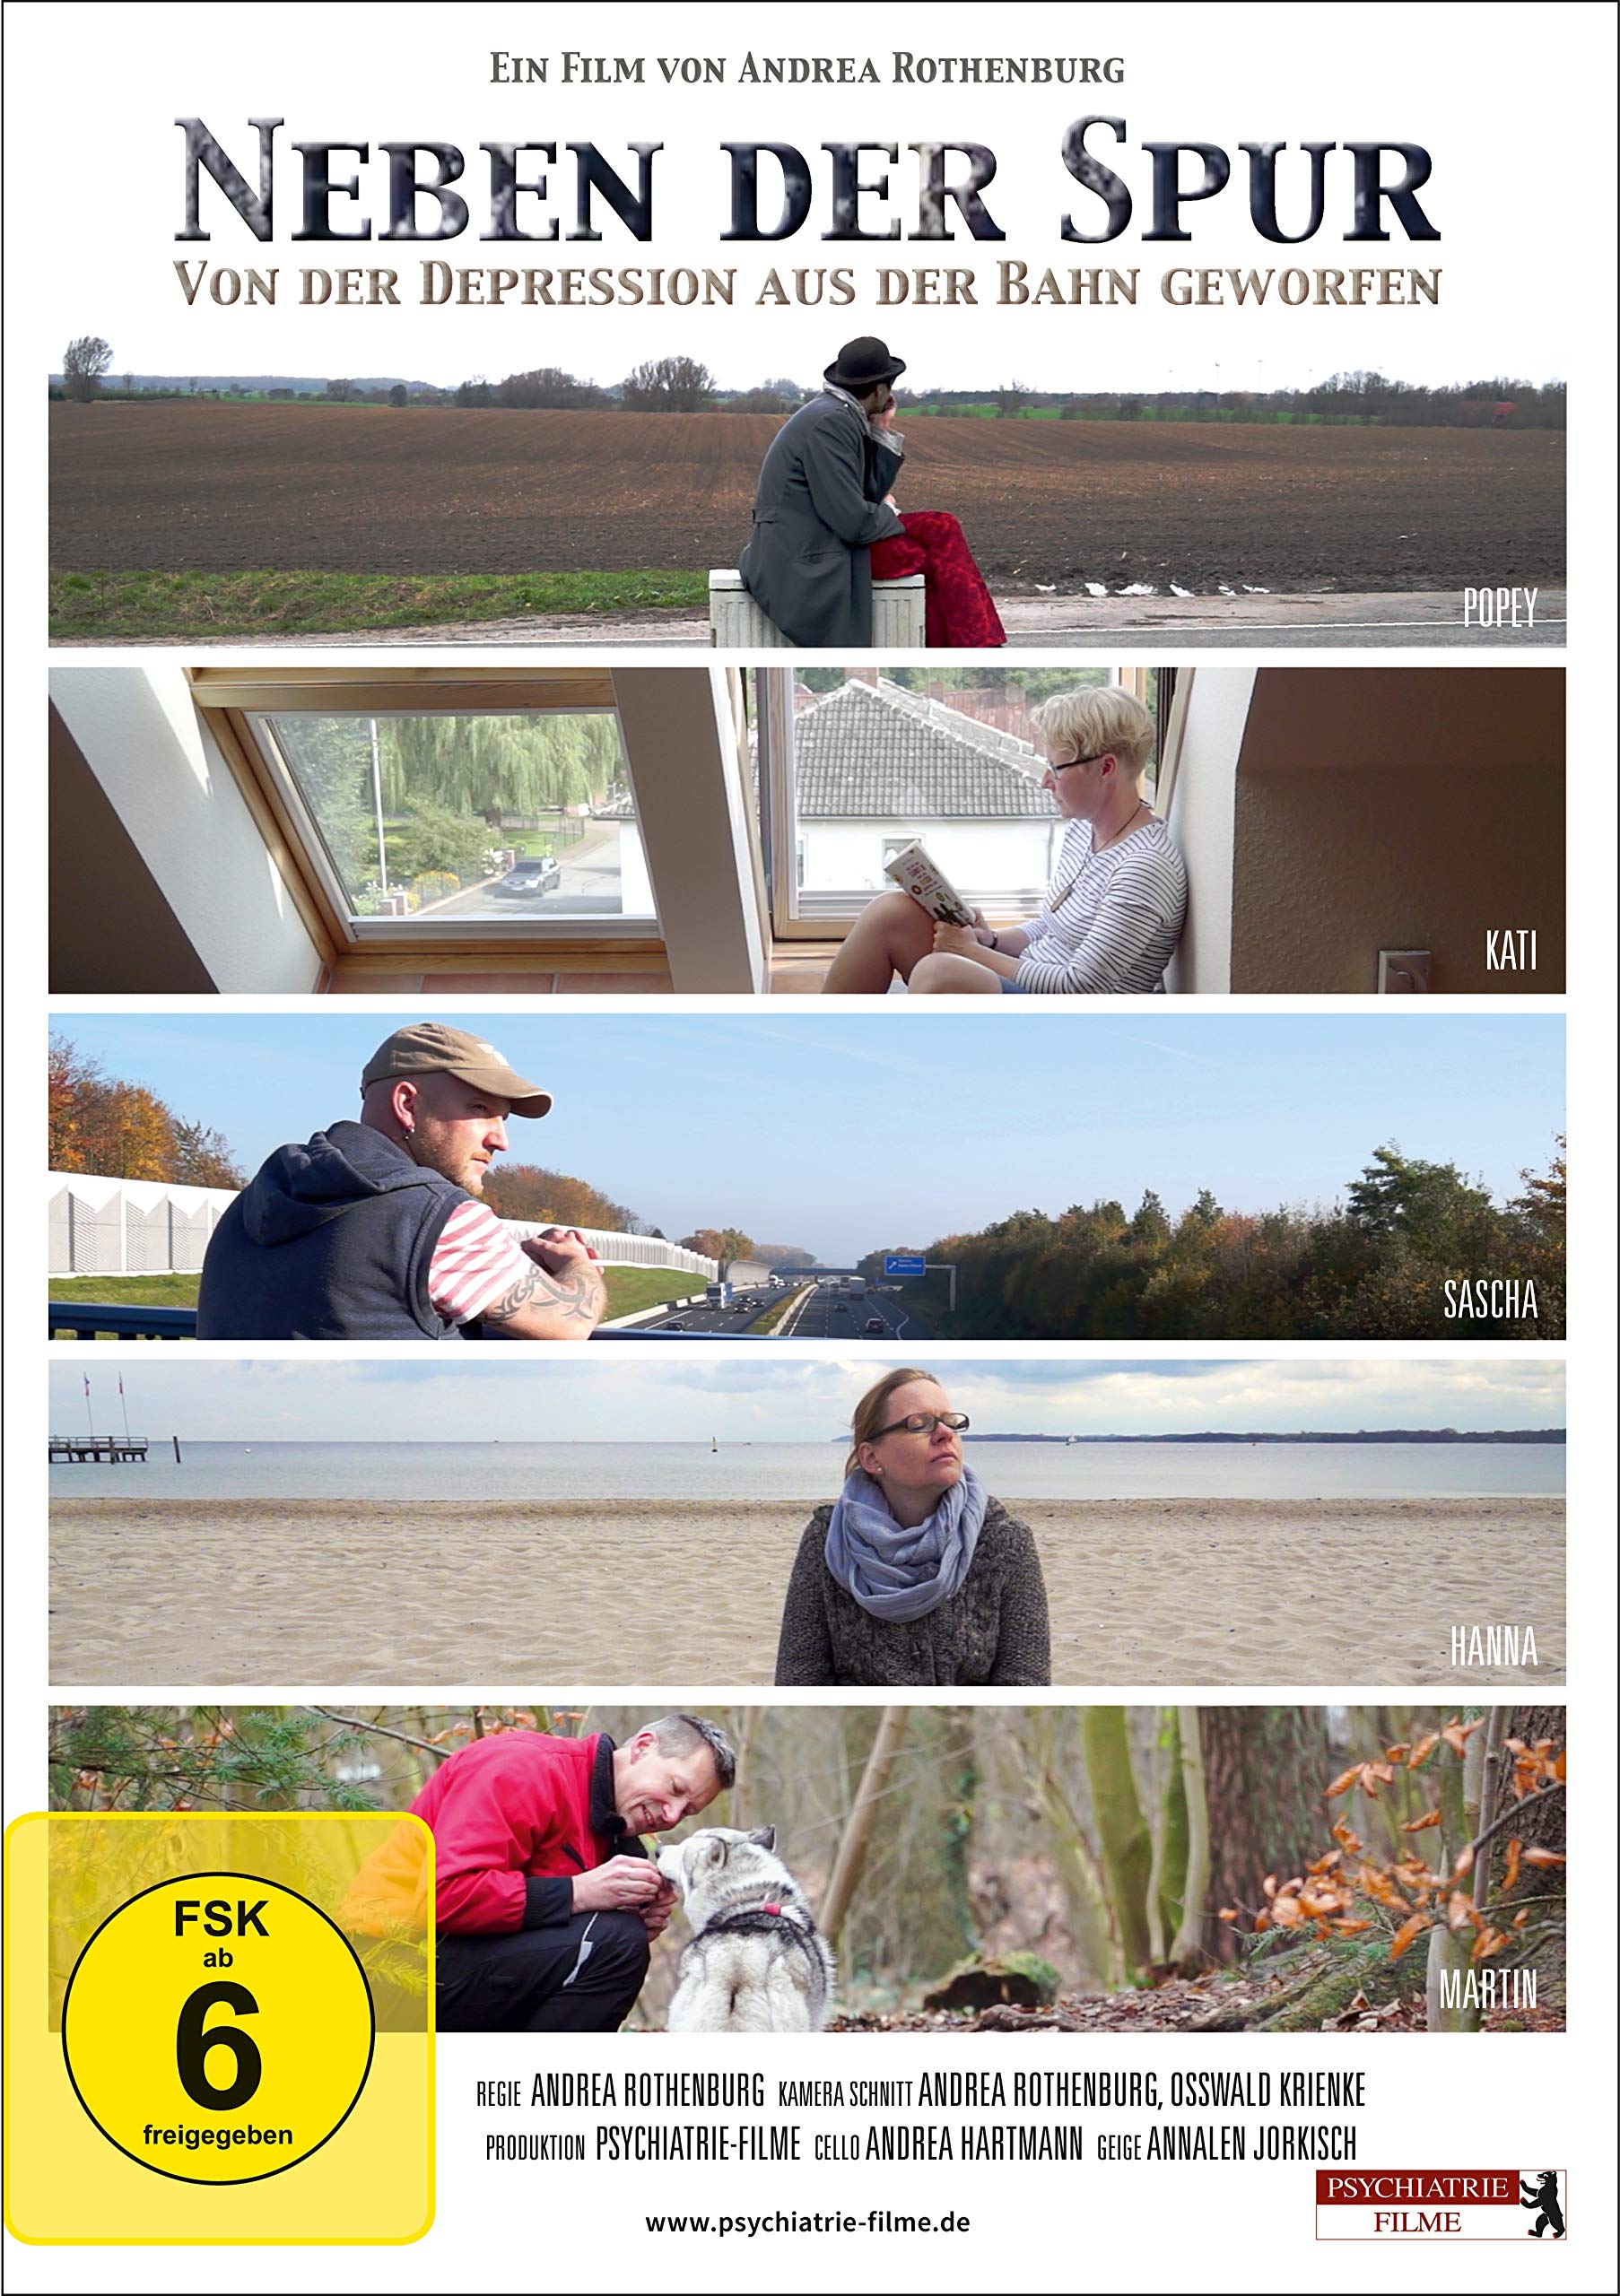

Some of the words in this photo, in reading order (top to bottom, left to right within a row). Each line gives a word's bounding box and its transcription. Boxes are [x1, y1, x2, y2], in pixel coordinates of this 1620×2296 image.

[491, 52, 549, 83] EIN
[562, 52, 645, 83] FILM
[658, 58, 726, 83] VON
[738, 51, 880, 83] ANDREA
[893, 52, 1123, 83] ROTHENBURG
[174, 117, 664, 242] NEBEN
[720, 142, 1006, 241] DER
[1061, 116, 1441, 244] SPUR
[173, 260, 279, 305] VON
[299, 269, 401, 304] DER
[420, 261, 736, 305] DEPRESSION
[755, 268, 855, 305] AUS
[876, 269, 978, 305] DER
[997, 261, 1140, 304] BAHN
[1161, 268, 1442, 305] GEWORFEN
[1464, 587, 1538, 627] POPEY
[1486, 930, 1537, 970] KATI
[1444, 1279, 1538, 1318] SASCHA
[1451, 1625, 1538, 1665] HANNA
[176, 1900, 269, 1936] FSK
[204, 1948, 232, 1967] ab
[1440, 1969, 1537, 2009] MARTIN
[177, 1981, 261, 2110] 6
[477, 2081, 520, 2107] REGIE
[531, 2073, 616, 2107] ANDREA
[625, 2073, 764, 2107] ROTHENBURG
[780, 2081, 844, 2107] KAMERA
[850, 2081, 912, 2107] SCHNITT
[919, 2073, 1006, 2107] ANDREA
[1015, 2073, 1163, 2109] ROTHENBURG,
[1171, 2073, 1270, 2107] OSSWALD
[1281, 2073, 1364, 2107] KRIENKE
[144, 2125, 292, 2150] freigegeben
[487, 2135, 584, 2161] PRODUKTION
[597, 2126, 800, 2161] PSYCHIATRIE-FILME
[815, 2135, 859, 2161] CELLO
[866, 2126, 953, 2161] ANDREA
[962, 2126, 1082, 2161] HARTMANN
[1098, 2135, 1141, 2161] GEIGE
[1147, 2126, 1244, 2161] ANNALEN
[1254, 2126, 1355, 2161] JORKISCH
[1328, 2178, 1509, 2198] PSYCHIATRIE
[646, 2211, 971, 2238] www.psychiatrie-filme.de
[1374, 2213, 1462, 2232] FILME
